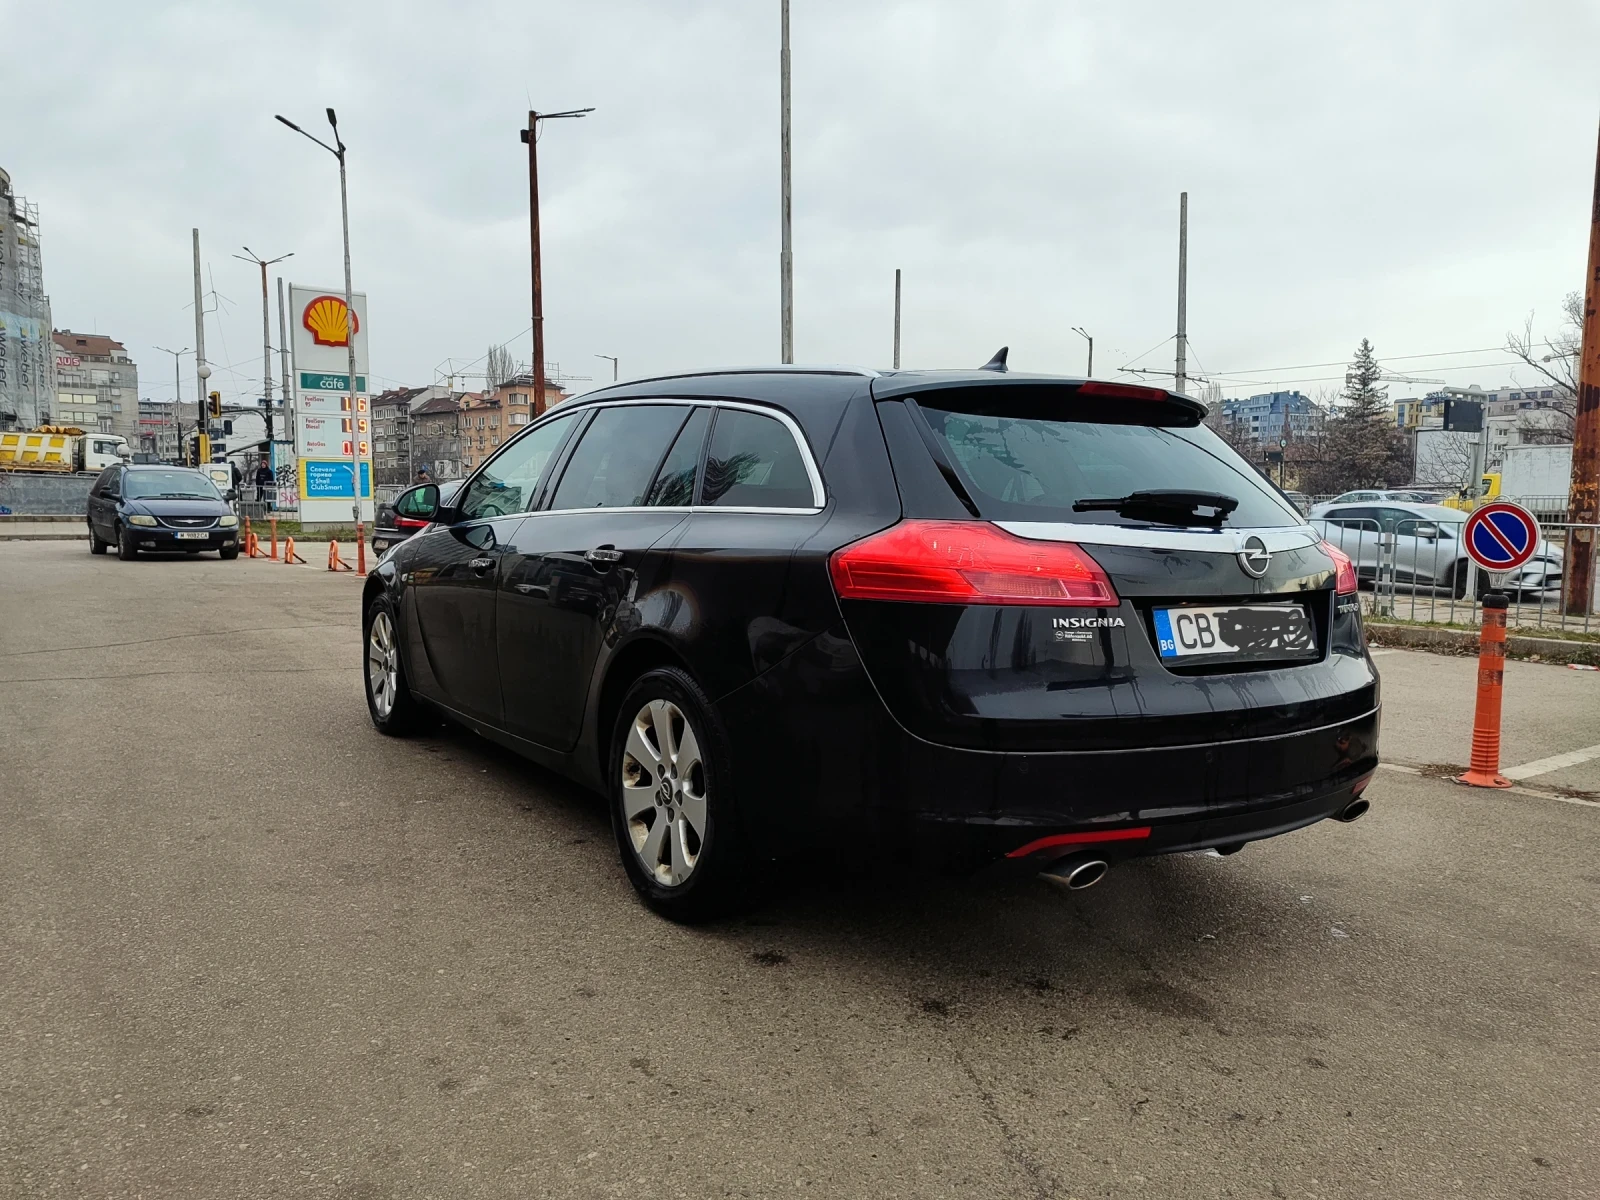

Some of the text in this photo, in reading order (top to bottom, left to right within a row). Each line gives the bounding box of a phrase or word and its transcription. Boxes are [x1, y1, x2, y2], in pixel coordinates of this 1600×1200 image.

[20, 340, 30, 391] weber
[37, 340, 46, 391] weber
[320, 377, 344, 389] café
[1052, 617, 1126, 628] INSIGNIA
[1176, 613, 1216, 649] CB
[1159, 639, 1175, 651] BG
